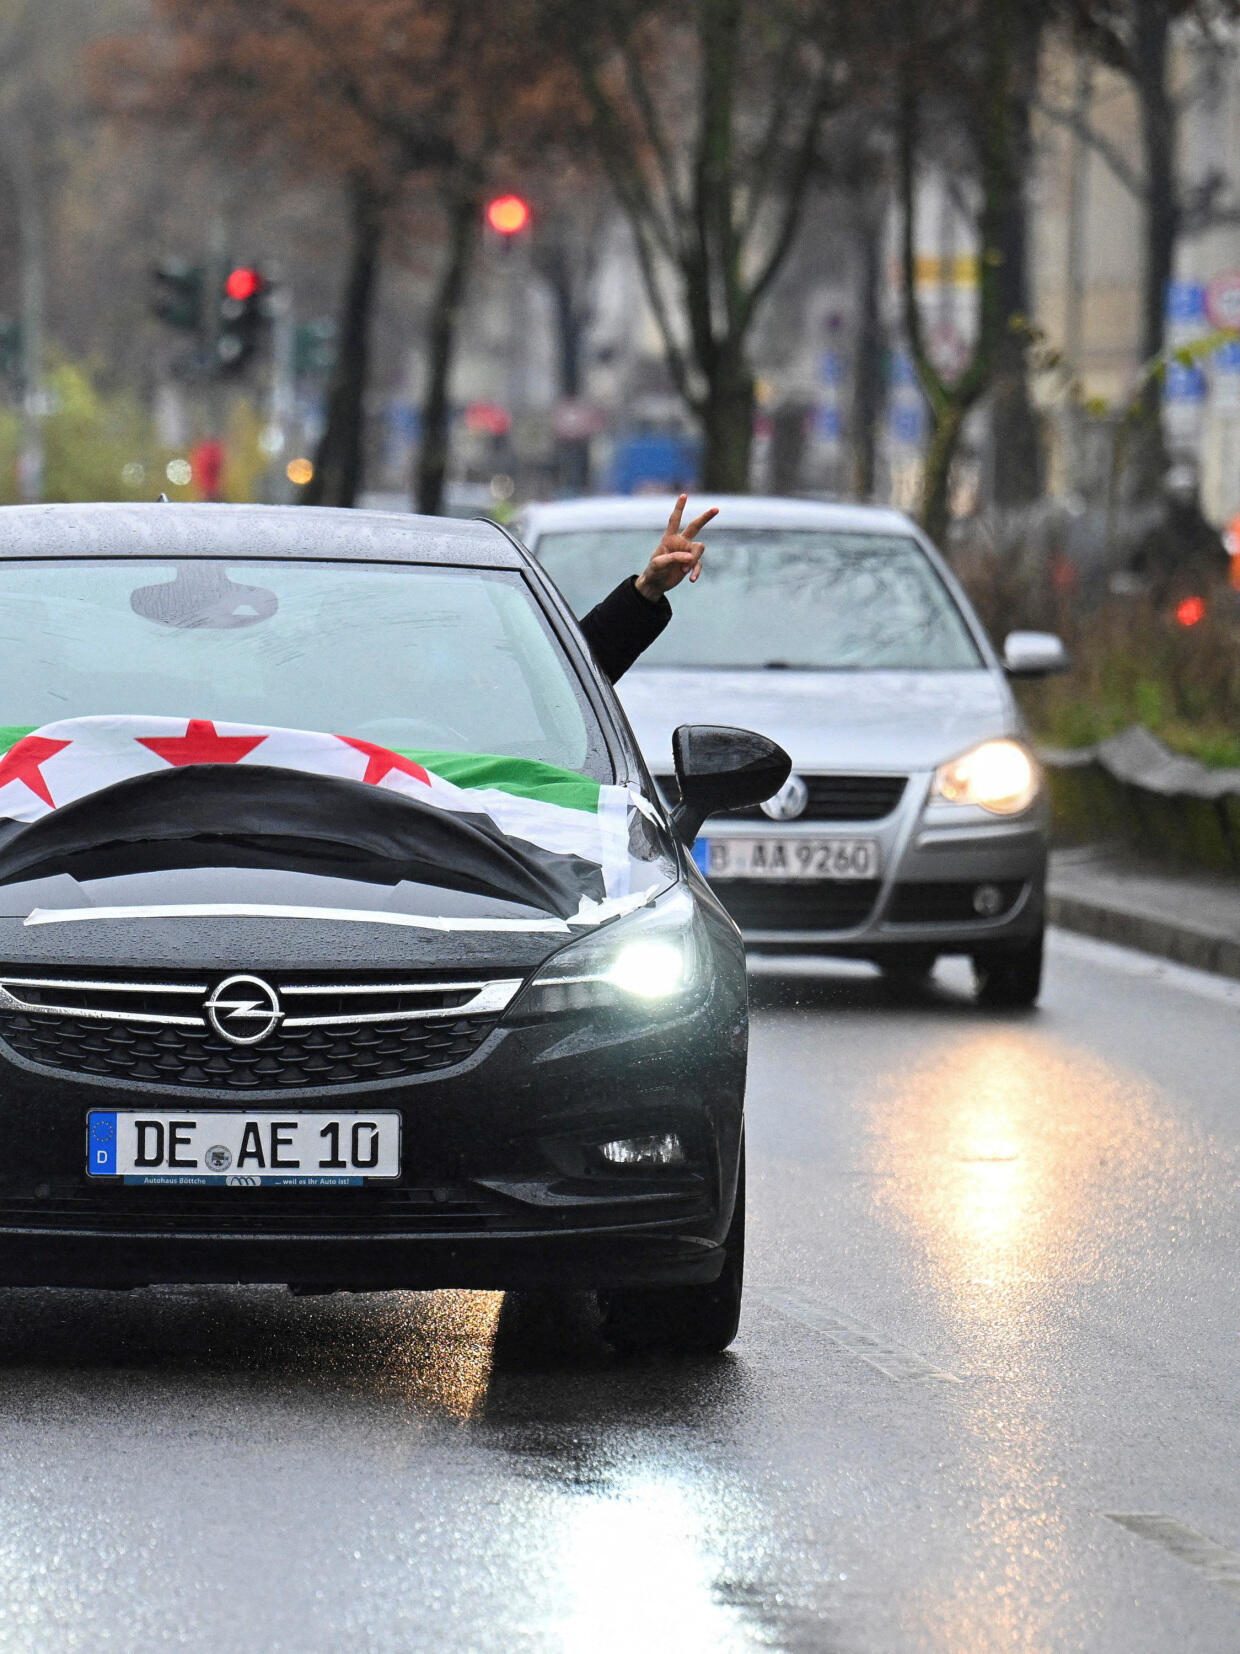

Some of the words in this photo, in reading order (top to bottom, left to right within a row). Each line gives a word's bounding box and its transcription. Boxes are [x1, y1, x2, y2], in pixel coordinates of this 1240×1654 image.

[711, 843, 728, 873] B
[751, 842, 788, 873] AA
[795, 843, 871, 874] 9260
[133, 1119, 199, 1169] DE
[236, 1120, 301, 1169] AE
[318, 1120, 380, 1169] 10
[96, 1150, 108, 1164] D
[143, 1176, 178, 1185] Autohaus
[319, 1178, 337, 1186] Auto
